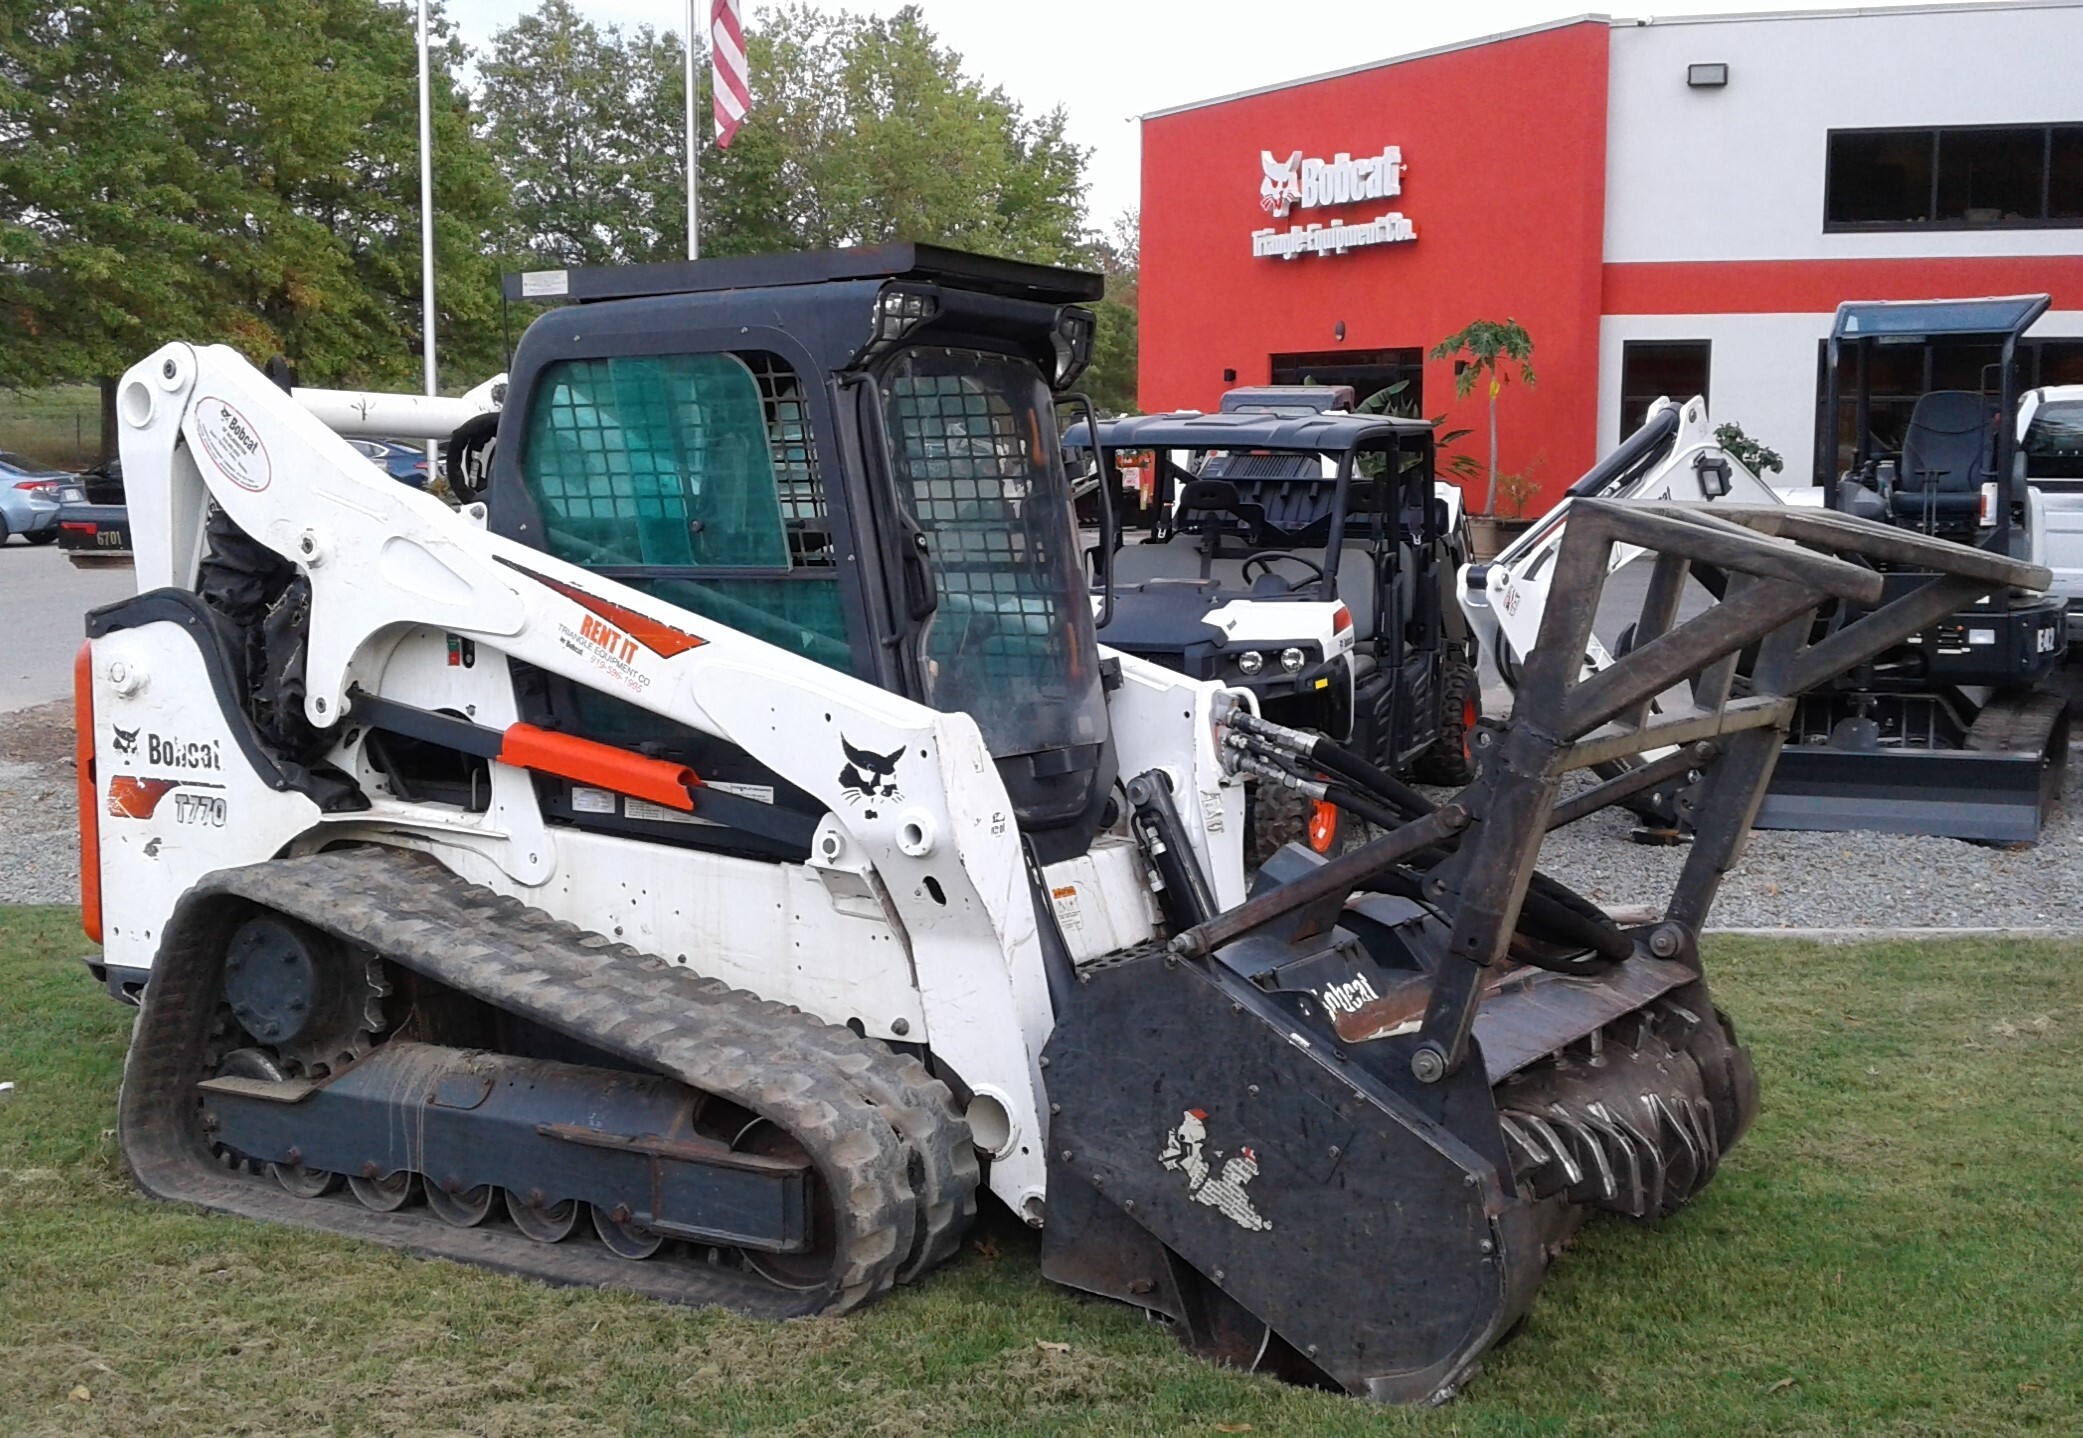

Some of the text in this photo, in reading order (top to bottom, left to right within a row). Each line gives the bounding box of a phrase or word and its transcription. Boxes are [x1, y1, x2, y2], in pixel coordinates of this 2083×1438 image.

[1302, 146, 1401, 208] Bobcat
[1251, 225, 1303, 260] Triangle
[1306, 216, 1386, 256] Equipment
[229, 417, 258, 454] Bobcat
[96, 531, 122, 546] 6701
[558, 623, 650, 687] TRIANGLE EQUIPMENT CO
[580, 614, 638, 665] RENT IT
[175, 793, 227, 828] T770
